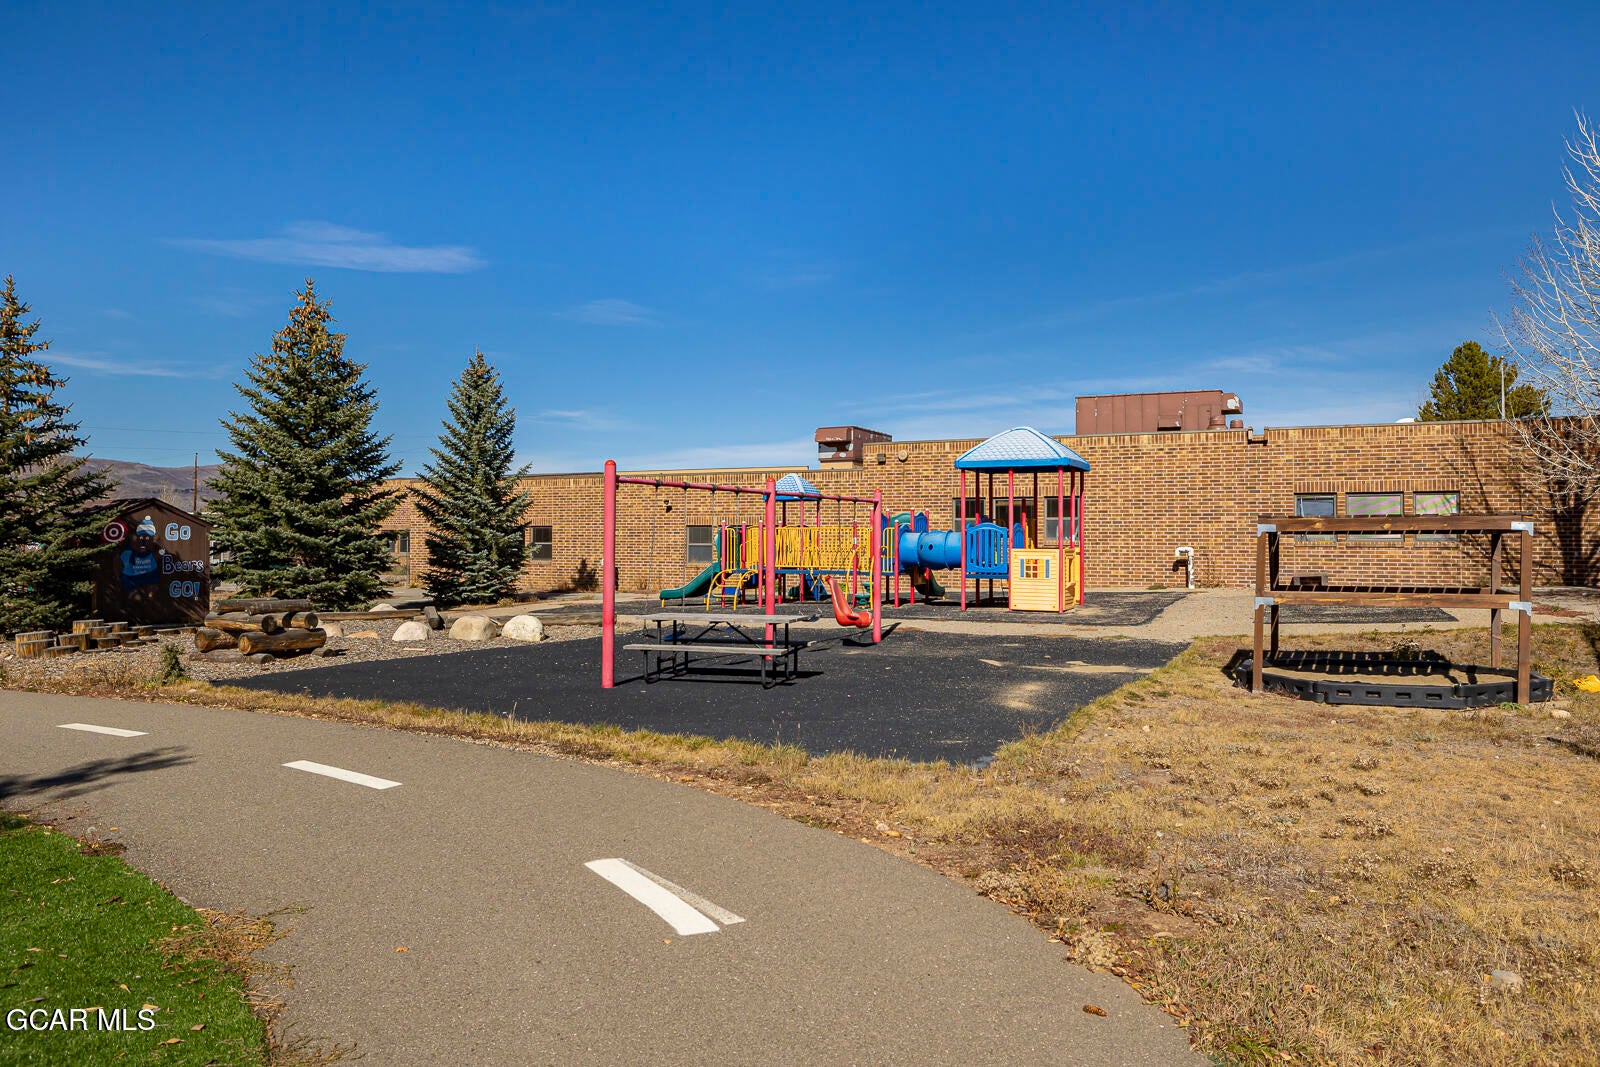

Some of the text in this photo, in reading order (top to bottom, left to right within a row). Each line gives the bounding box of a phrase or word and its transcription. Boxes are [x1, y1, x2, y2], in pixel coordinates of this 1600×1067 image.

[165, 522, 191, 541] Go
[162, 554, 204, 575] Bears
[168, 580, 201, 601] GO!
